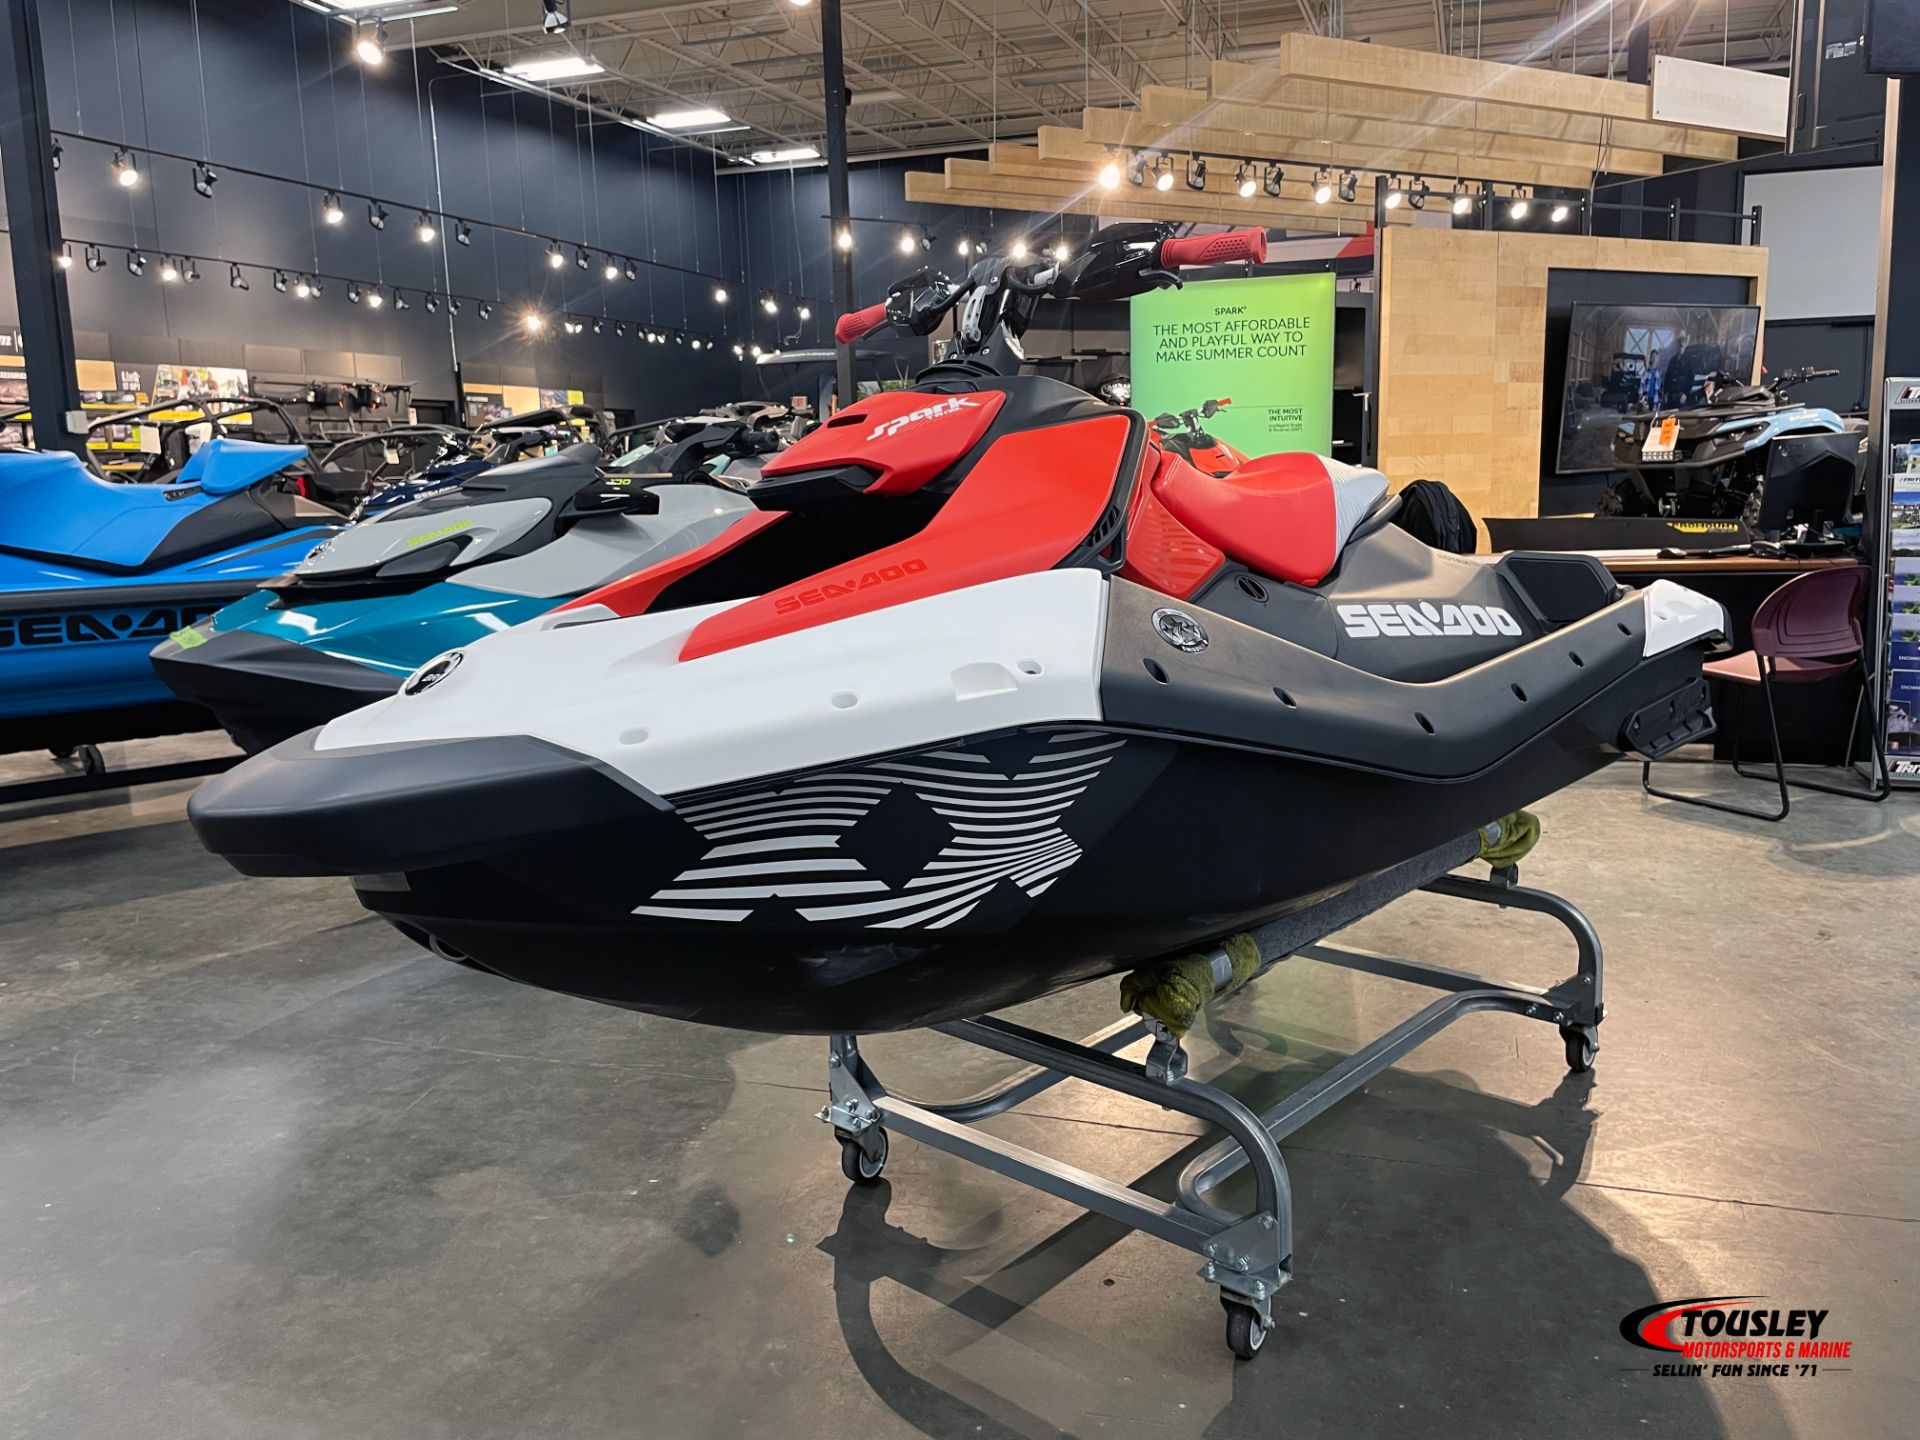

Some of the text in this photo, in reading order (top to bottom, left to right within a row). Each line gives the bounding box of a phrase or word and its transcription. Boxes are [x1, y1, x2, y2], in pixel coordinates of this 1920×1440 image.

[1152, 316, 1311, 336] THE MOST AFFORDABLE
[1159, 330, 1303, 349] AND PLAYFUL WAY TO
[1156, 344, 1307, 363] MAKE SUMMER COUNT
